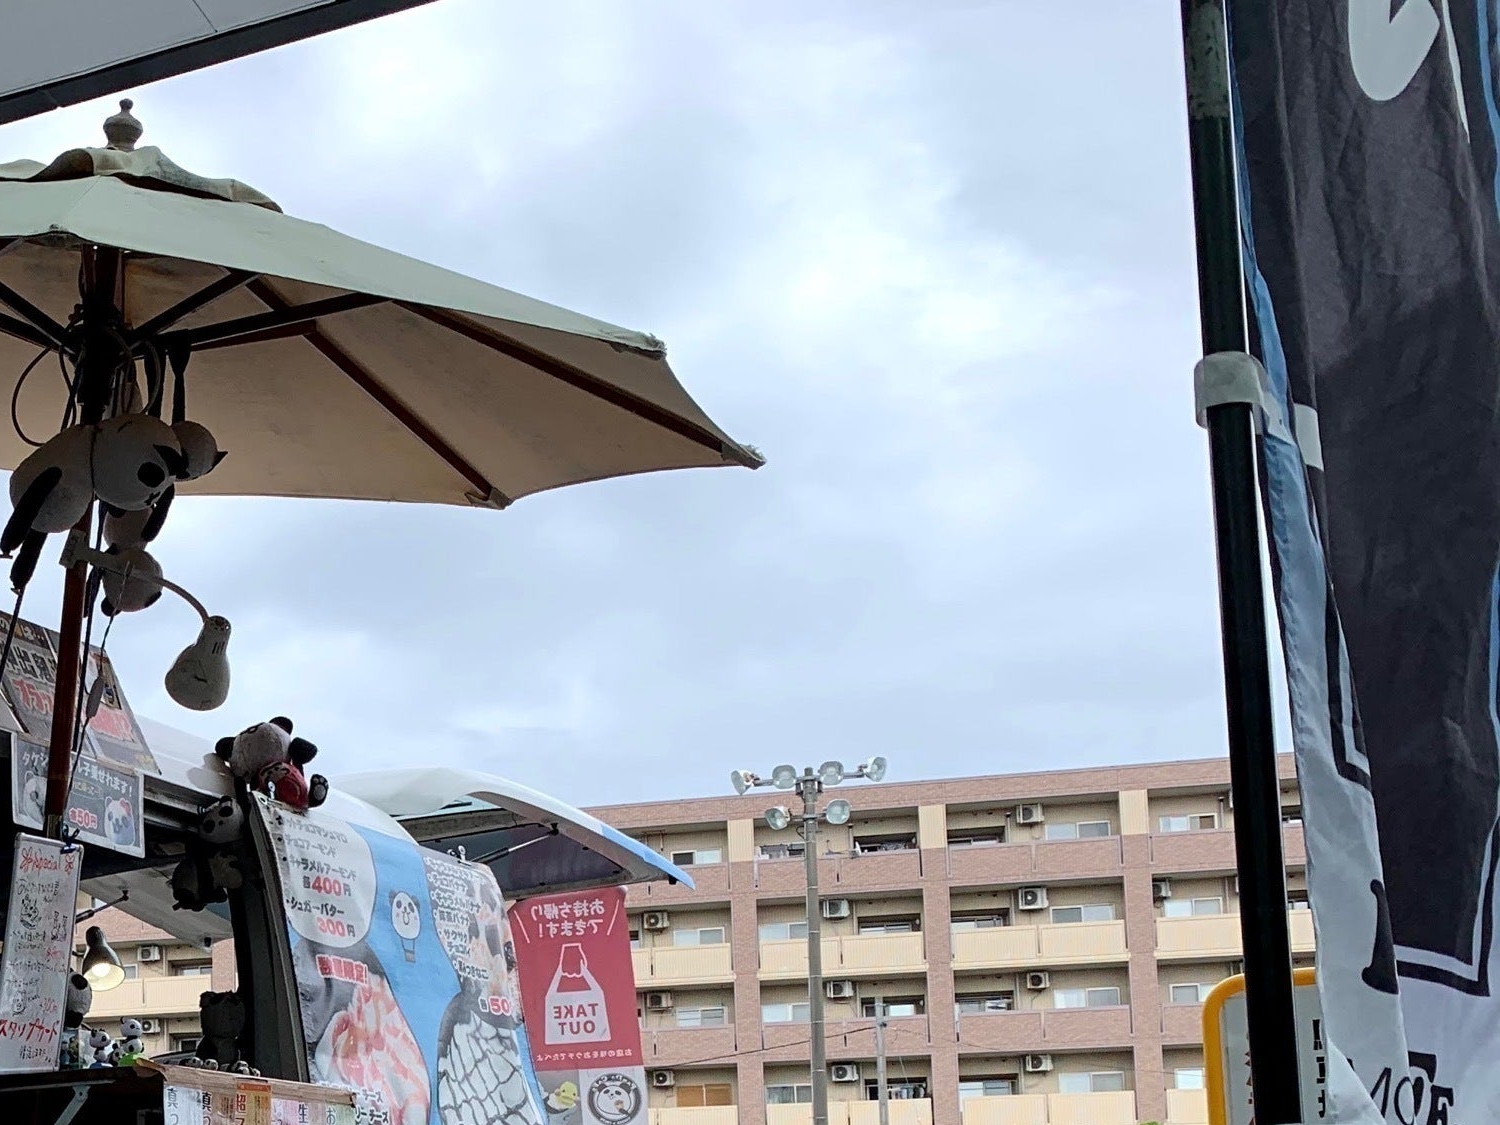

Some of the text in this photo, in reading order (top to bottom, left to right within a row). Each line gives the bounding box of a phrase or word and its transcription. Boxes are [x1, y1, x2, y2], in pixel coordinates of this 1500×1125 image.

[289, 853, 357, 882] キャラメルアーモンド
[302, 874, 351, 897] 各400円
[290, 897, 345, 919] シュガーバター
[316, 917, 356, 938] 300円
